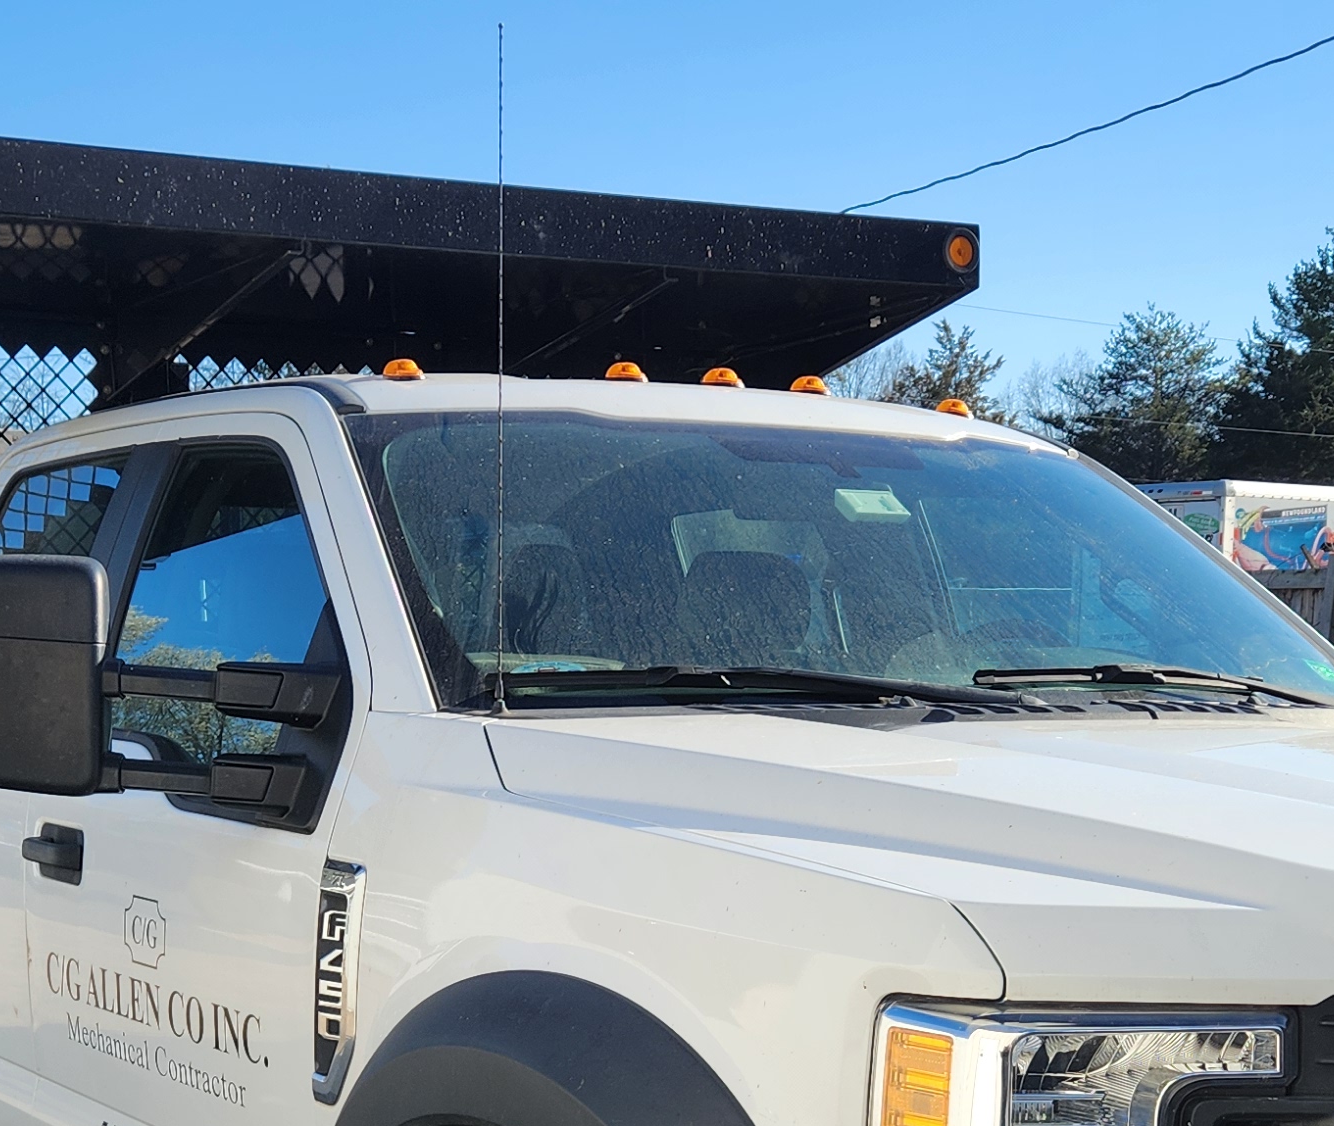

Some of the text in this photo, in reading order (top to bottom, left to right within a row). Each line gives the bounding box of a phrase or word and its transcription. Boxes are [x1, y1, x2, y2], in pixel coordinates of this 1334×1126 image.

[1281, 506, 1326, 518] NEWFOUNDLAND
[131, 915, 157, 949] C/G
[46, 952, 269, 1068] C/G ALLEN CO INC.
[66, 1012, 246, 1108] Mechanical Contractor
